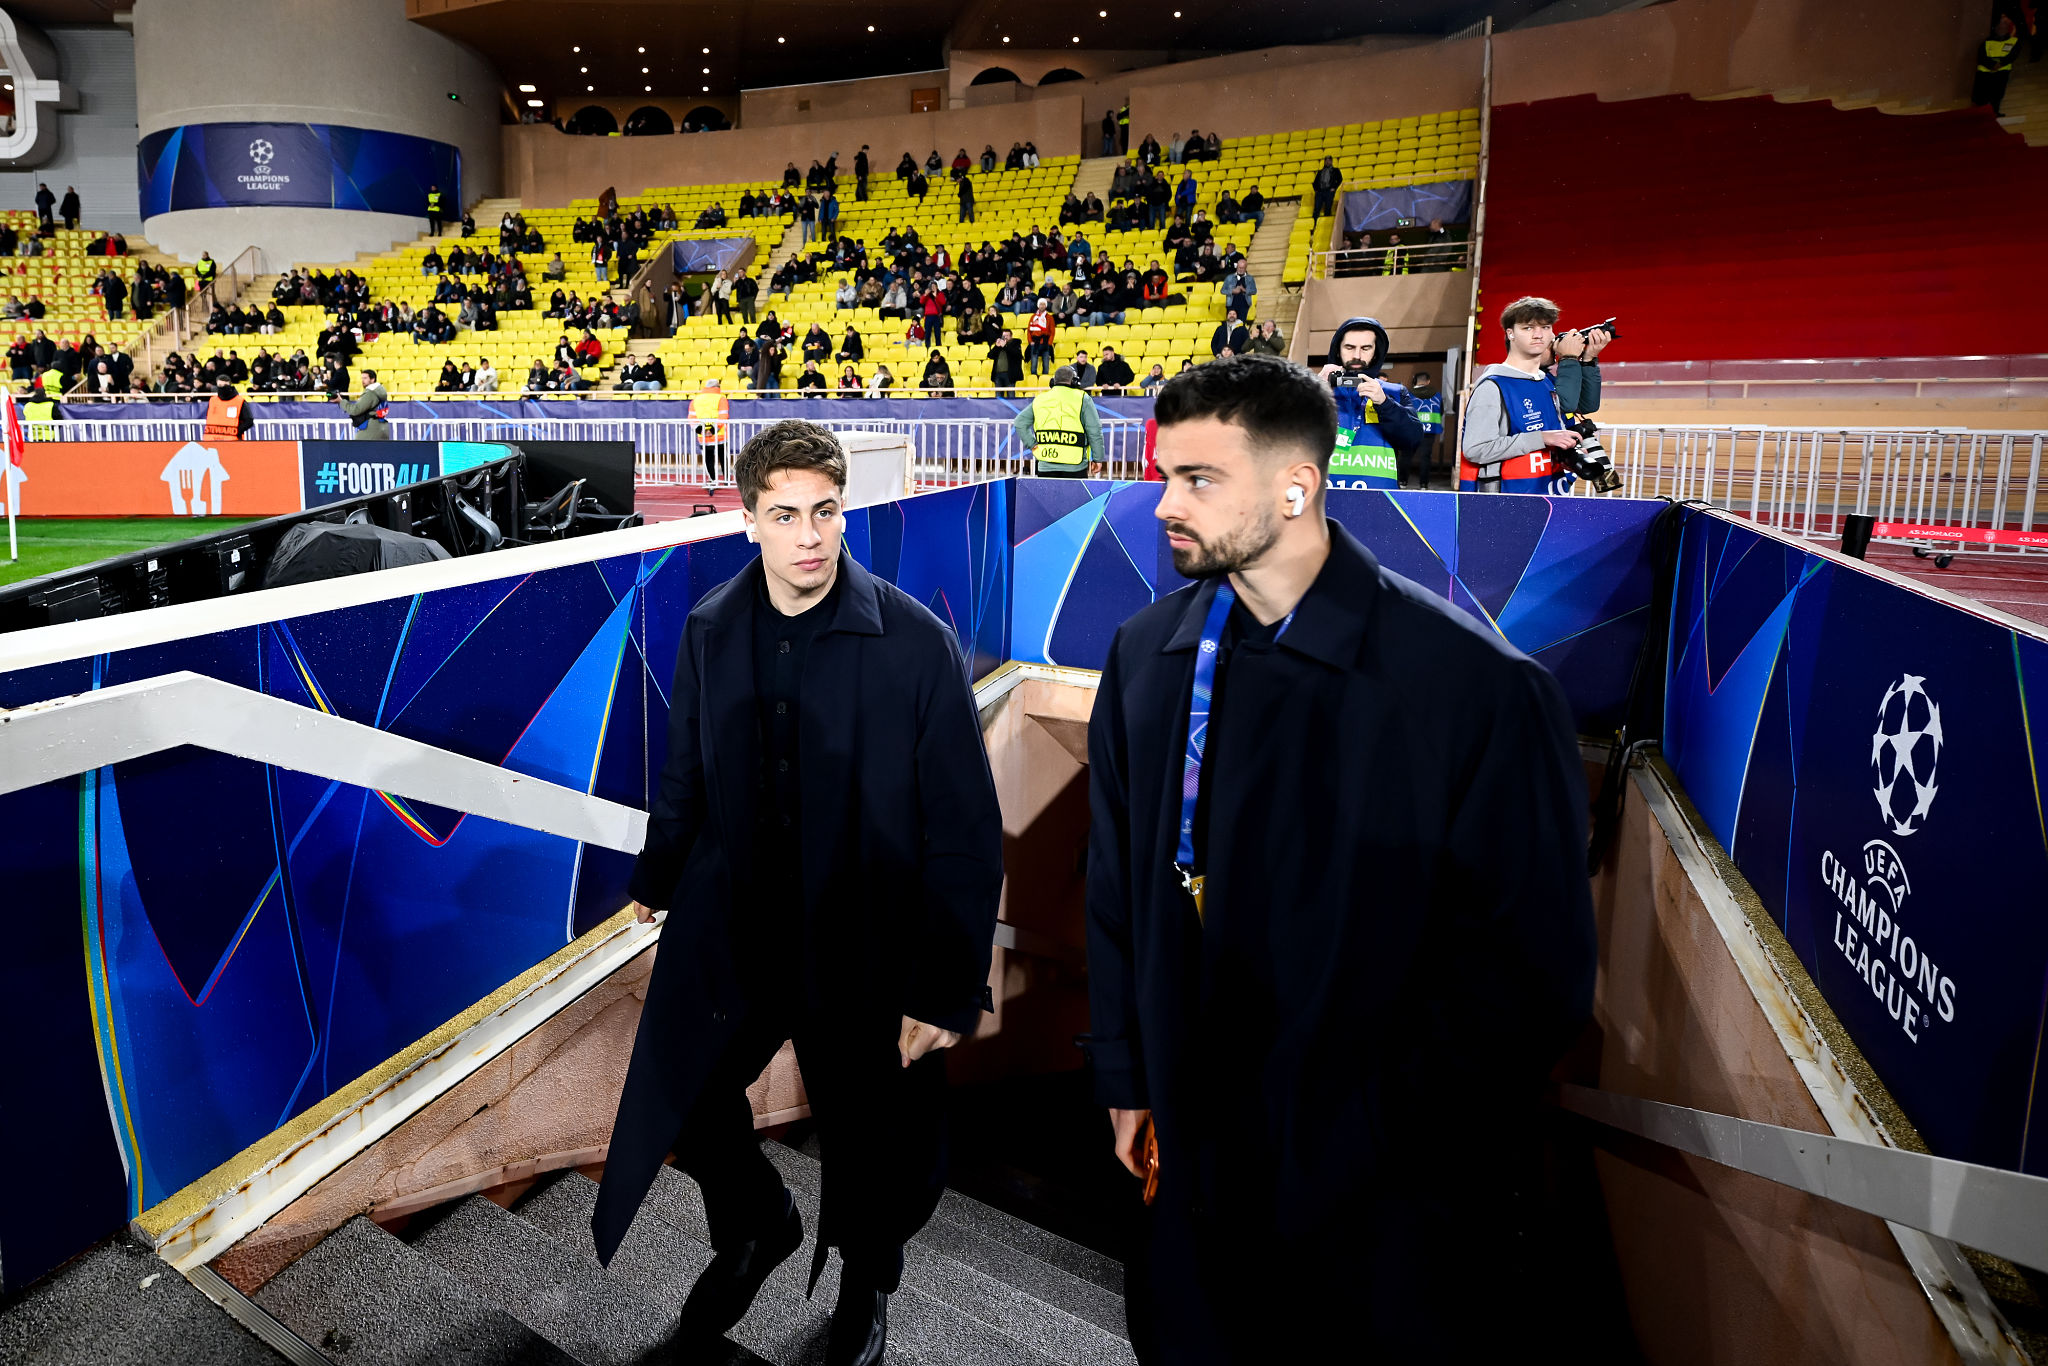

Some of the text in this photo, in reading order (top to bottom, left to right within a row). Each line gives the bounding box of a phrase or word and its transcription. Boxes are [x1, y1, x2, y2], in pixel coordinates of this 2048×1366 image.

[237, 175, 290, 183] CHAMPIONS
[247, 182, 281, 190] LEAGUE
[204, 425, 238, 436] STEWARD
[1036, 431, 1078, 445] TEWARD
[1921, 530, 1964, 538] MONACO
[1864, 848, 1905, 908] UEFA
[1821, 850, 1956, 1022] CHAMPIONS
[1833, 911, 1920, 1044] LEAGUE
